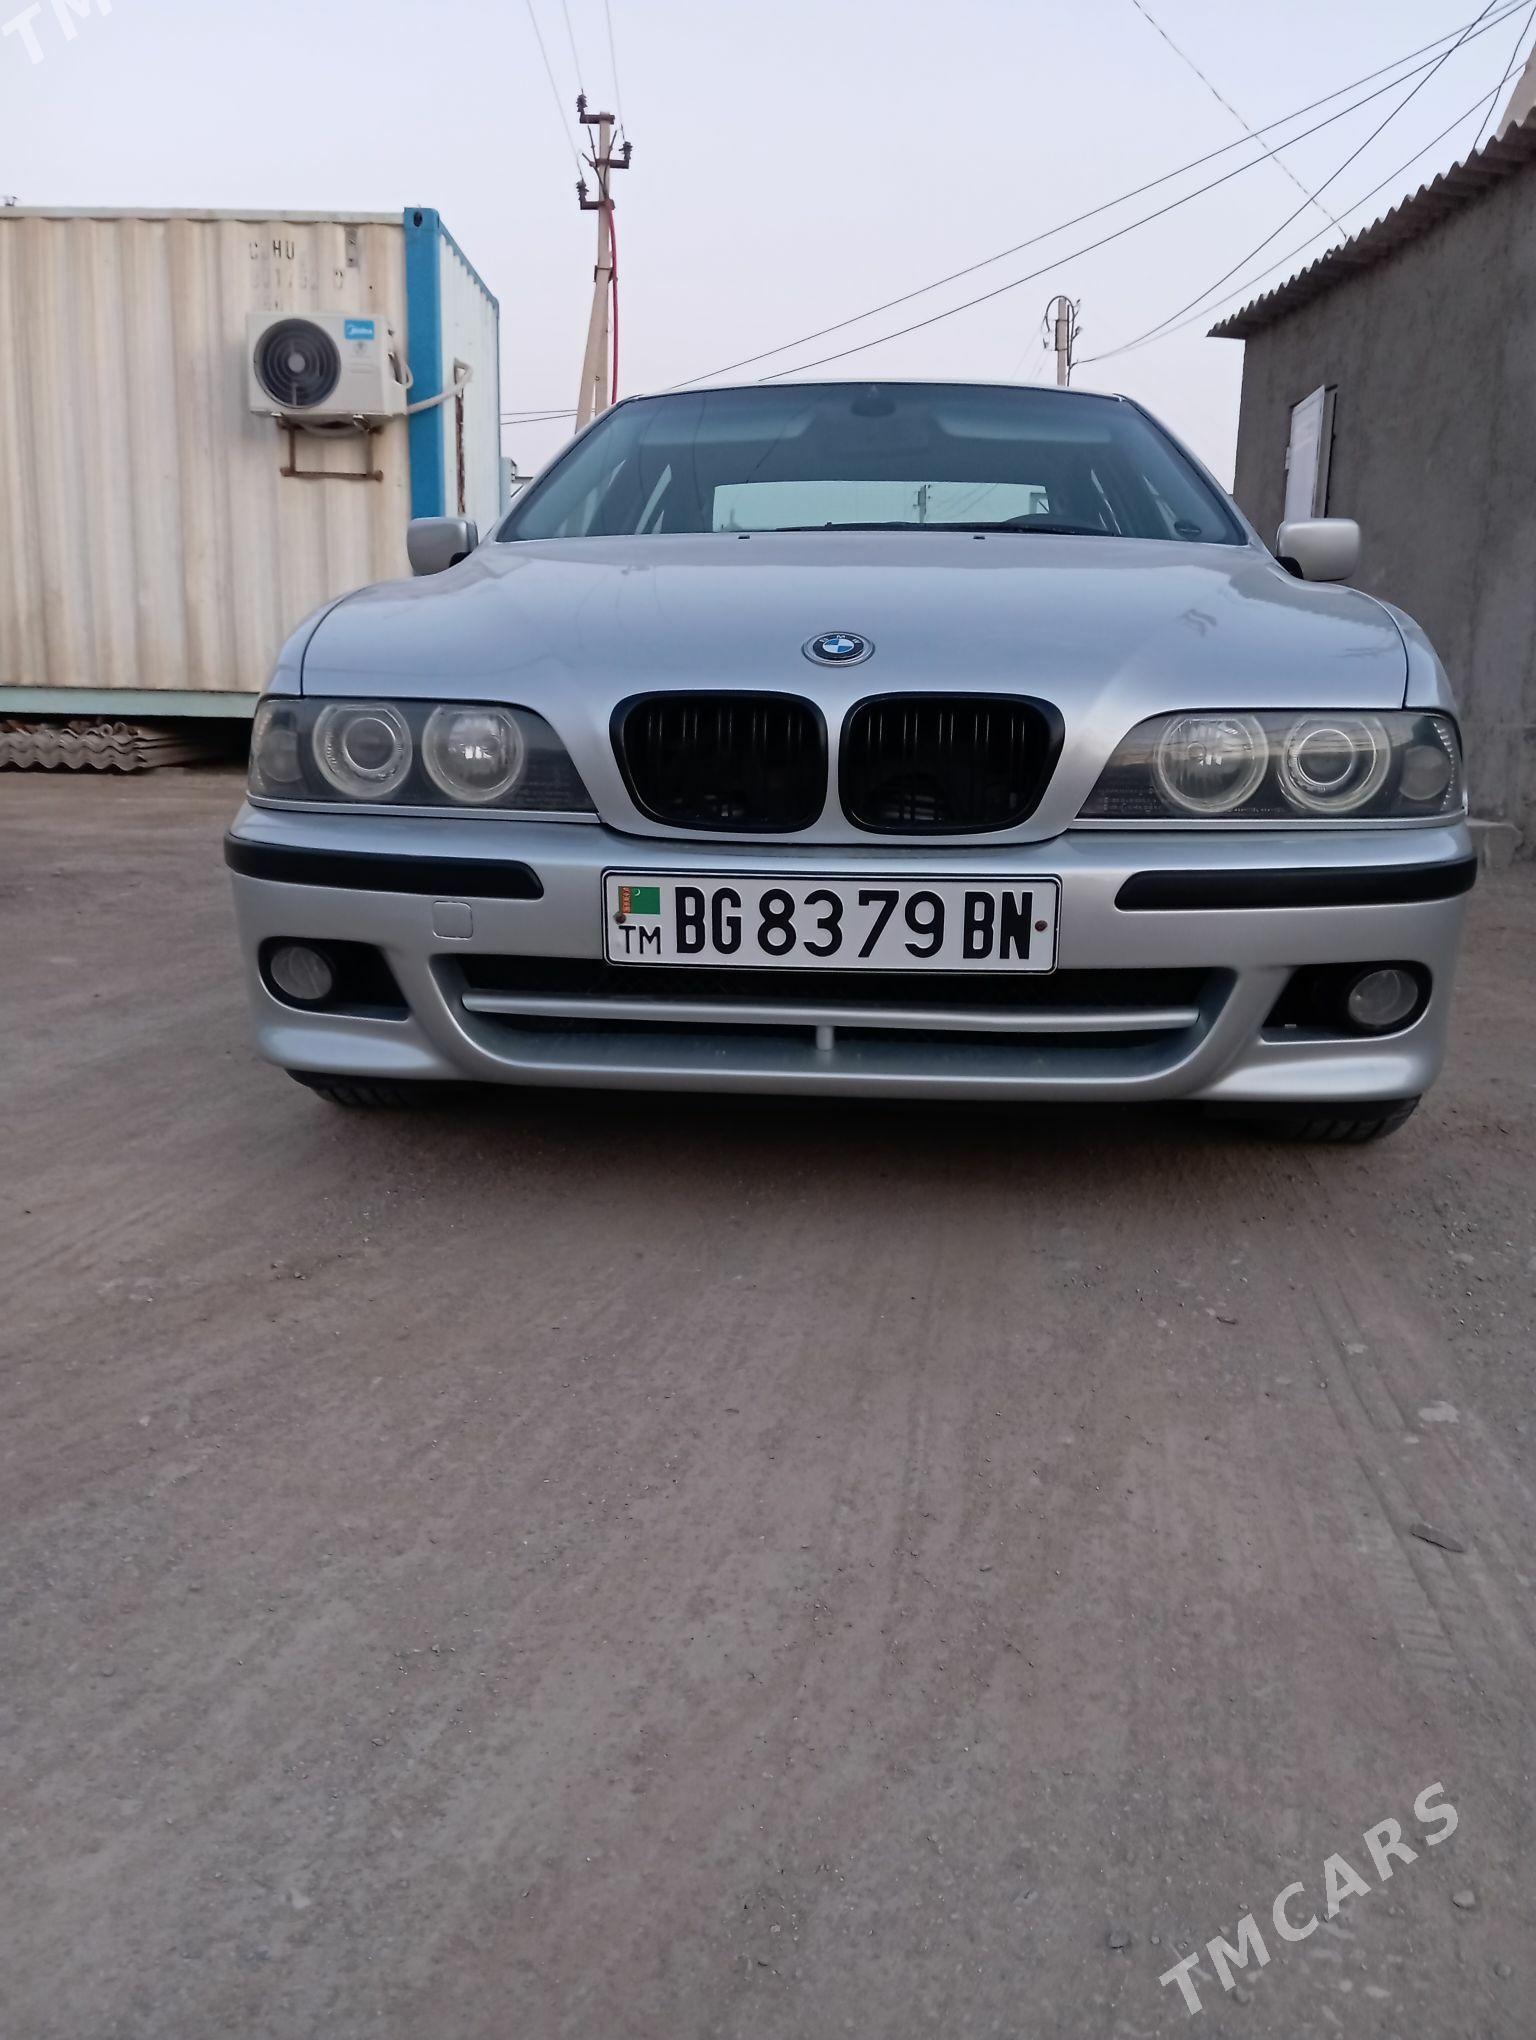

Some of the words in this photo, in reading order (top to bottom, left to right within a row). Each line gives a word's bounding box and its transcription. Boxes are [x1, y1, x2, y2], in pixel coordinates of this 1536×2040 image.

[619, 925, 661, 954] TM
[675, 887, 742, 955] BG
[757, 888, 945, 958] 8379
[963, 891, 1033, 960] BN
